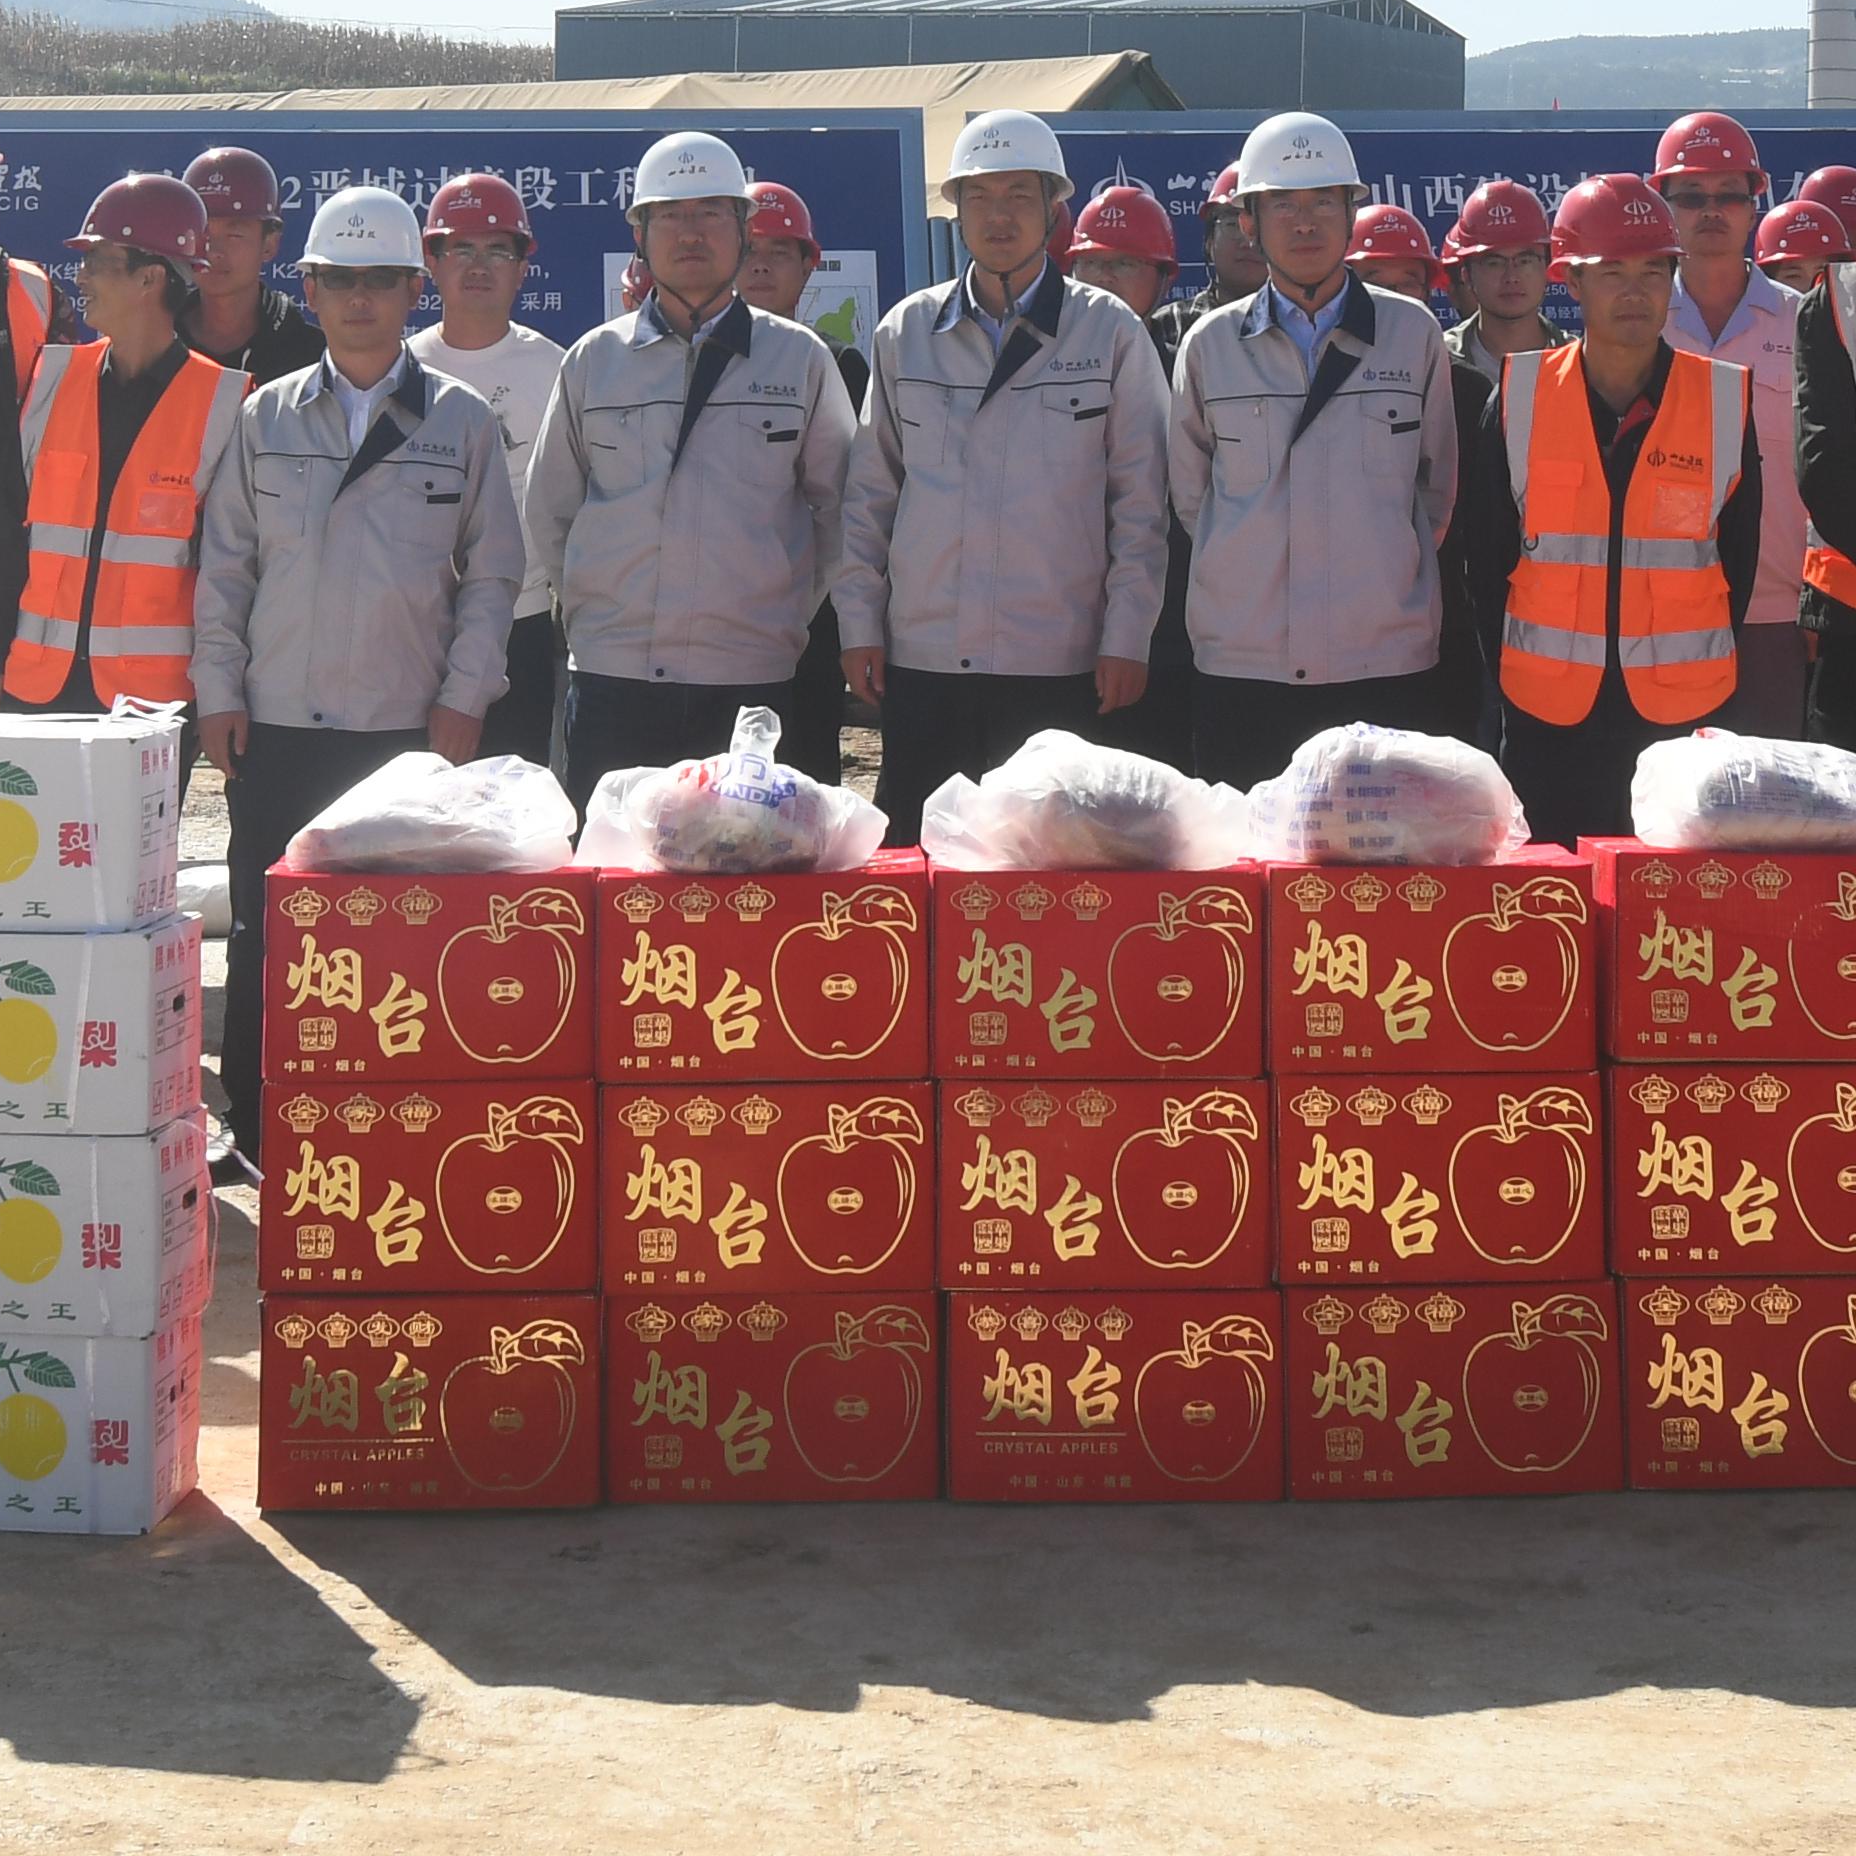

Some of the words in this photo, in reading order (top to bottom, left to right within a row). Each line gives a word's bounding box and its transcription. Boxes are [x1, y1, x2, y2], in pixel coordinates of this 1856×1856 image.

[520, 291, 563, 313] 采用
[285, 934, 427, 1061] 烟台
[621, 930, 761, 1058] 烟台
[956, 928, 1097, 1052] 烟台
[1293, 920, 1433, 1043] 烟台
[80, 1020, 117, 1067] 梨
[284, 1141, 425, 1270] 烟台
[625, 1144, 767, 1273] 烟台
[1298, 1134, 1439, 1258] 烟台
[290, 1351, 428, 1434] 烟台
[983, 1345, 1121, 1427] 烟台
[1648, 1333, 1789, 1456] 烟台
[985, 1442, 1051, 1453] CRYSTAL
[1061, 1443, 1117, 1454] APPLES
